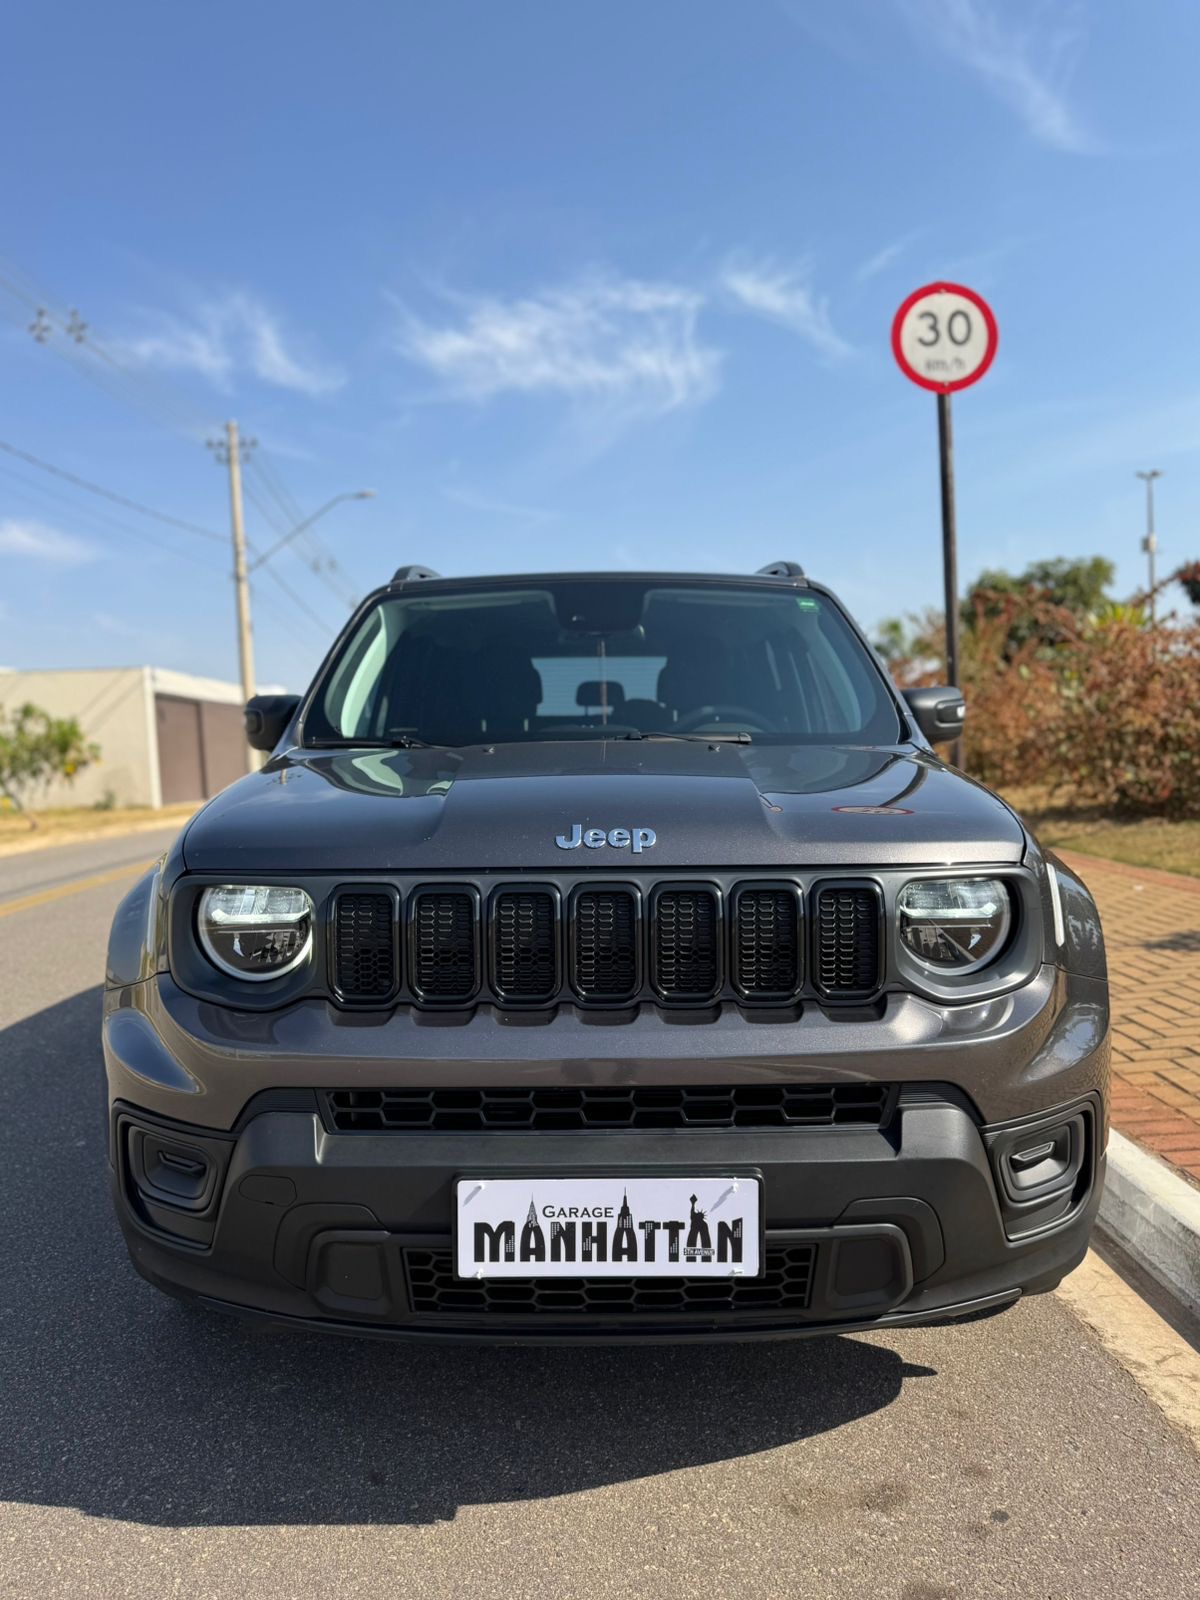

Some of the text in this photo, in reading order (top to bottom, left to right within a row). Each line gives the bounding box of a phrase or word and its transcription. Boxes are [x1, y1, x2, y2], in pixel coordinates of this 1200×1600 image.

[917, 310, 972, 347] 30
[555, 824, 657, 853] Jeep
[474, 1205, 743, 1263] MANHATTAN
